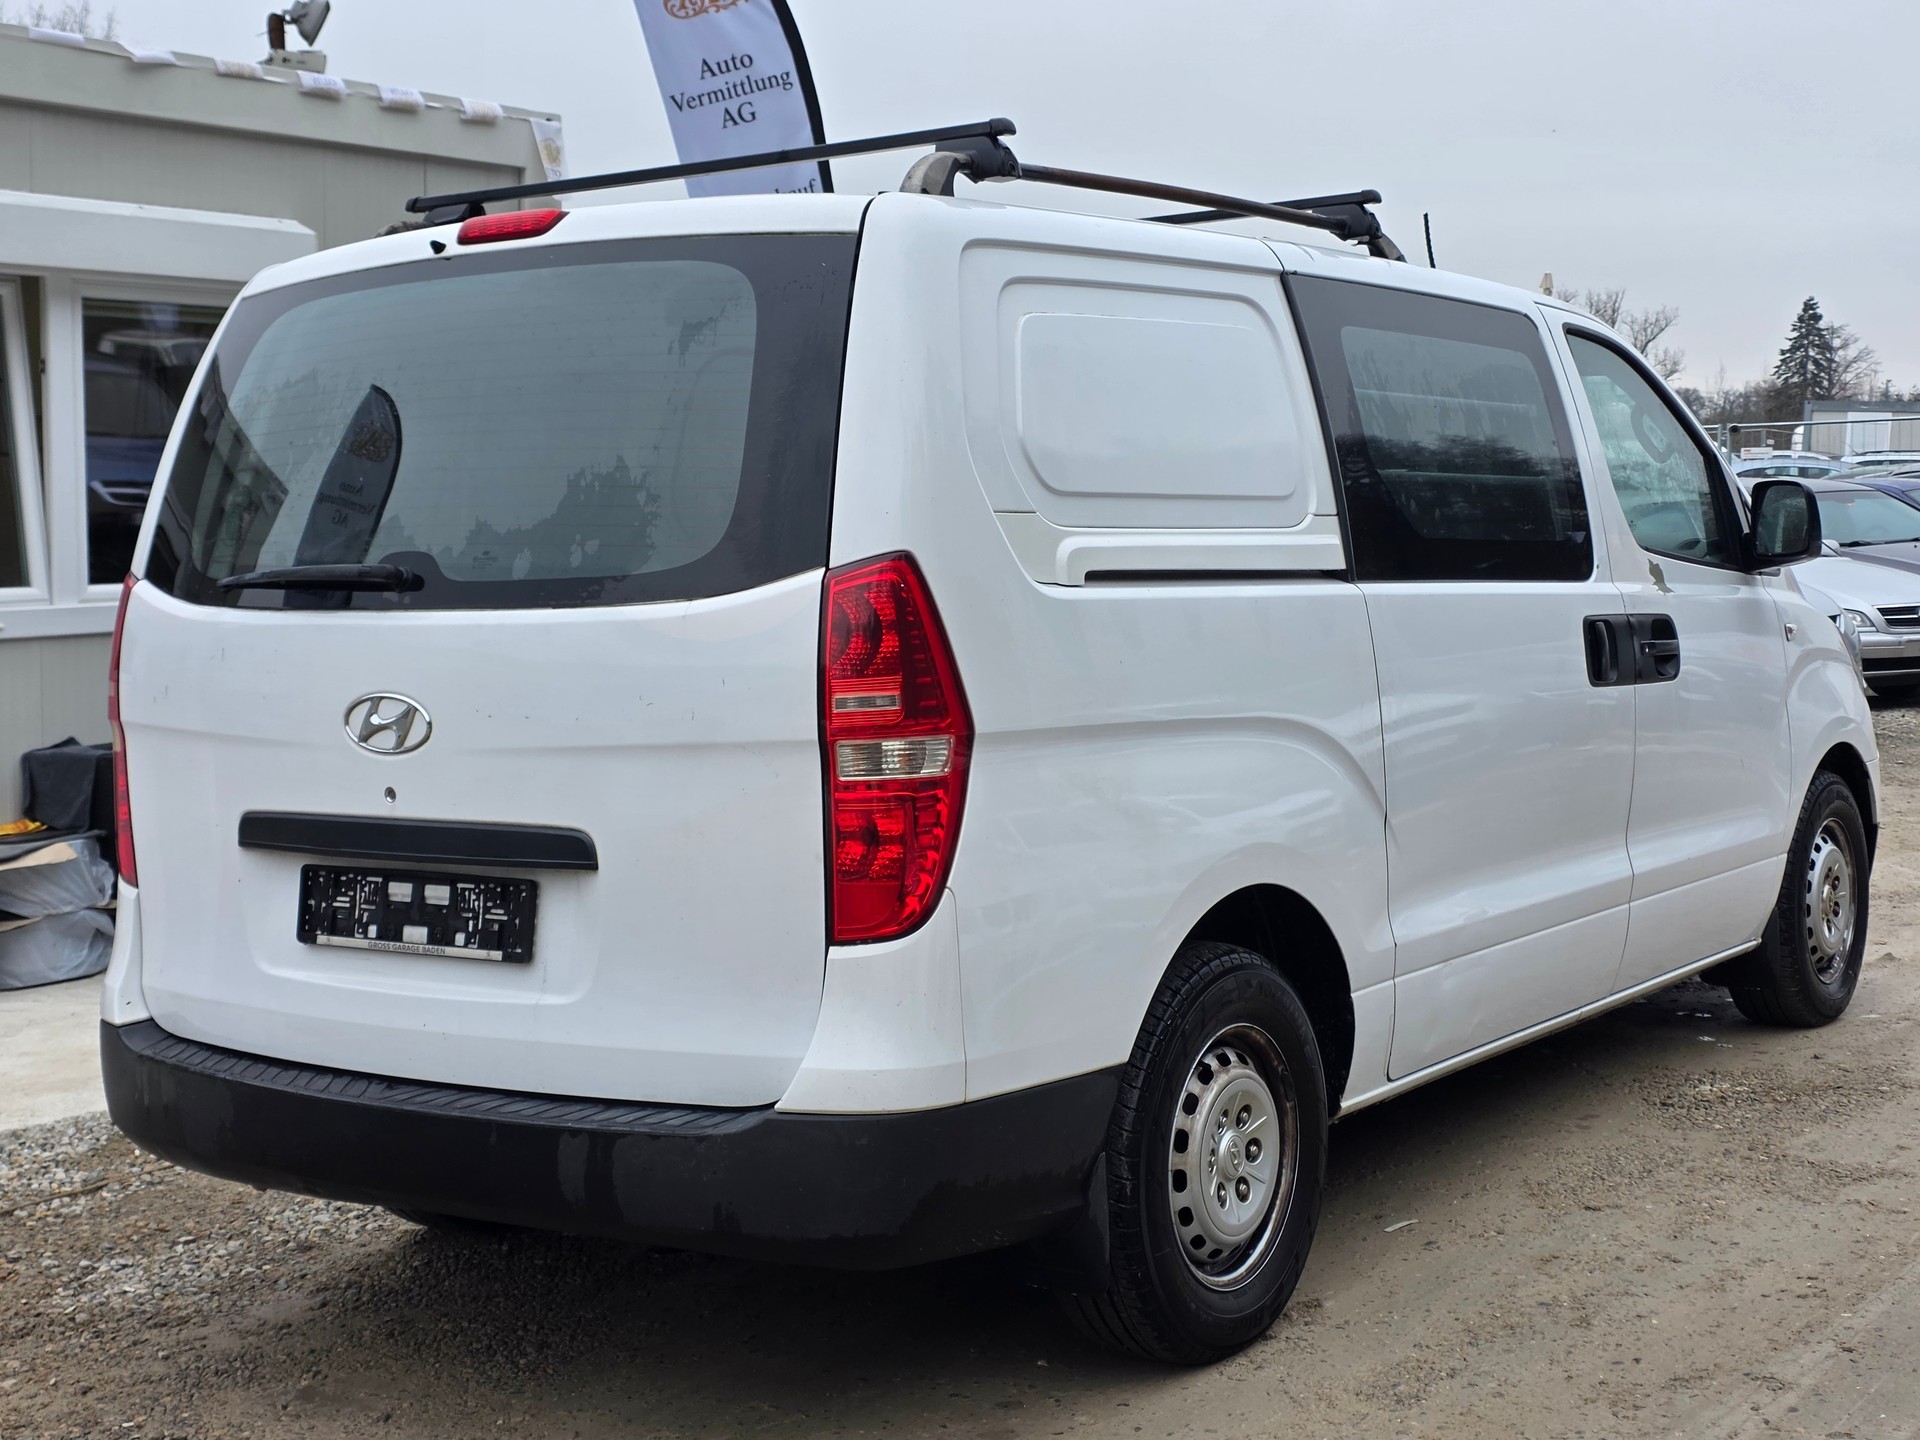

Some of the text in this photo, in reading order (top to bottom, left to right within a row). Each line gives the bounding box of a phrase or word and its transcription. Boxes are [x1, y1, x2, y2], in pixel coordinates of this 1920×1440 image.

[699, 53, 754, 80] Auto
[669, 71, 793, 113] Vermittlung
[721, 101, 757, 130] AG
[368, 941, 446, 956] GROSS GARAGE BADEN
